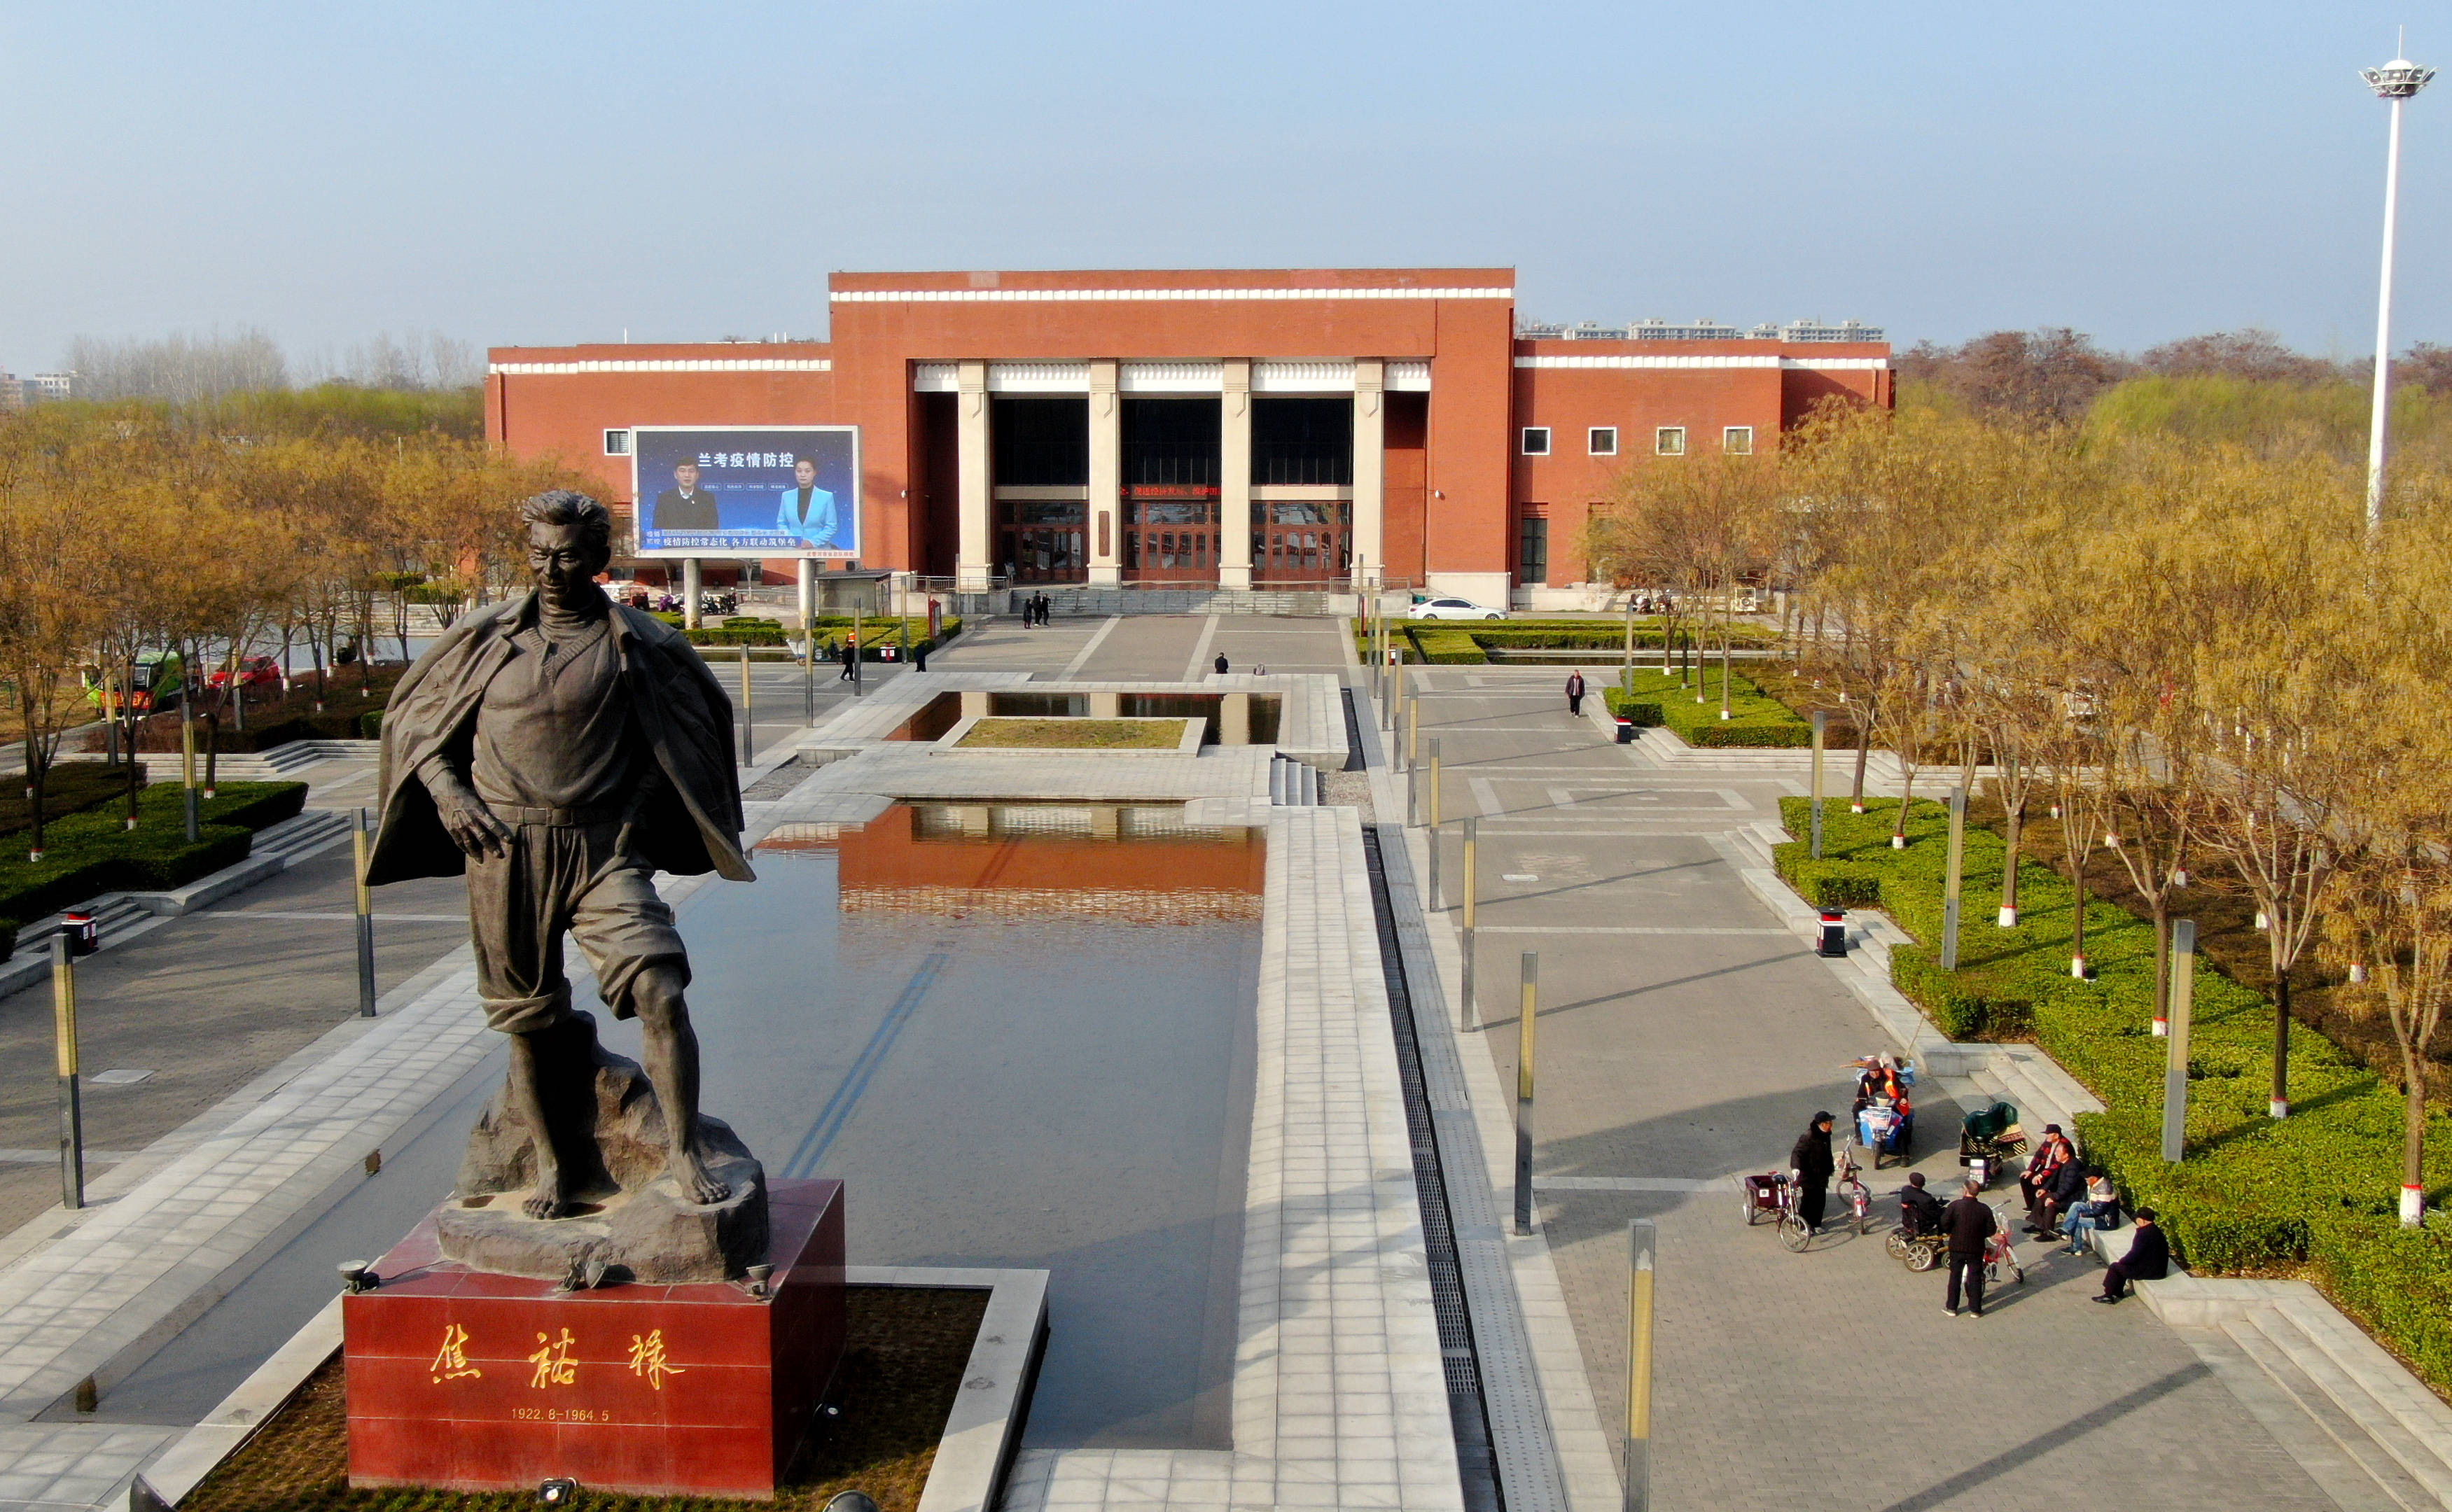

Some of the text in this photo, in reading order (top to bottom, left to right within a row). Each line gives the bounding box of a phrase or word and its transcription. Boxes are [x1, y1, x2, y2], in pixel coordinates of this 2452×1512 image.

[698, 452, 794, 468] 兰考疫情防控
[663, 537, 727, 546] 疫情防控常态化
[430, 1323, 685, 1390] 焦裕禄
